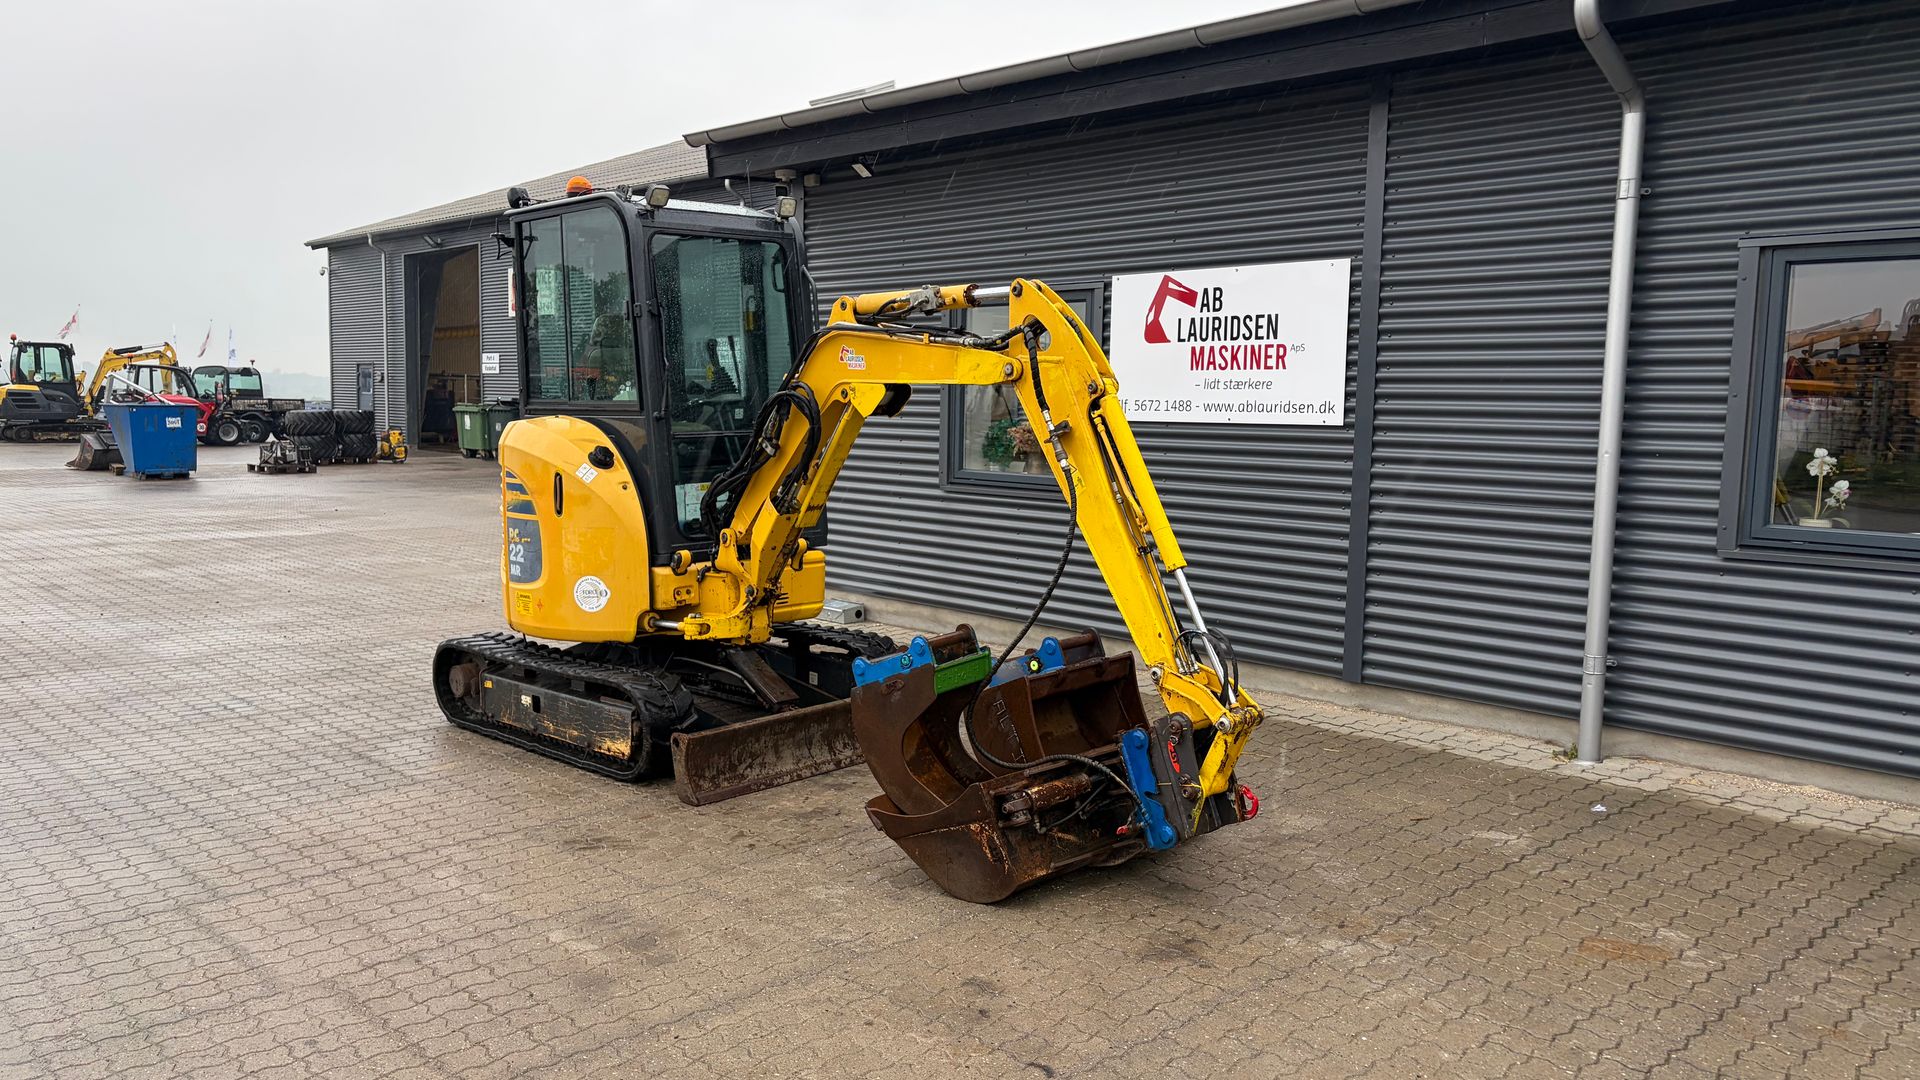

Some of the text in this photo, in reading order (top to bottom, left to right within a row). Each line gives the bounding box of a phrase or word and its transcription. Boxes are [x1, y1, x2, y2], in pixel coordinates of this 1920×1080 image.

[1199, 286, 1224, 314] AB
[1177, 313, 1279, 343] LAURIDSEN
[1189, 343, 1306, 371] MASKINER ApS
[1203, 377, 1221, 390] lidt
[1222, 377, 1273, 390] stærkere
[1134, 399, 1161, 412] 5672
[1163, 399, 1192, 412] 1488
[1203, 400, 1336, 414] www.ablauridsen.dk
[509, 543, 525, 563] 22
